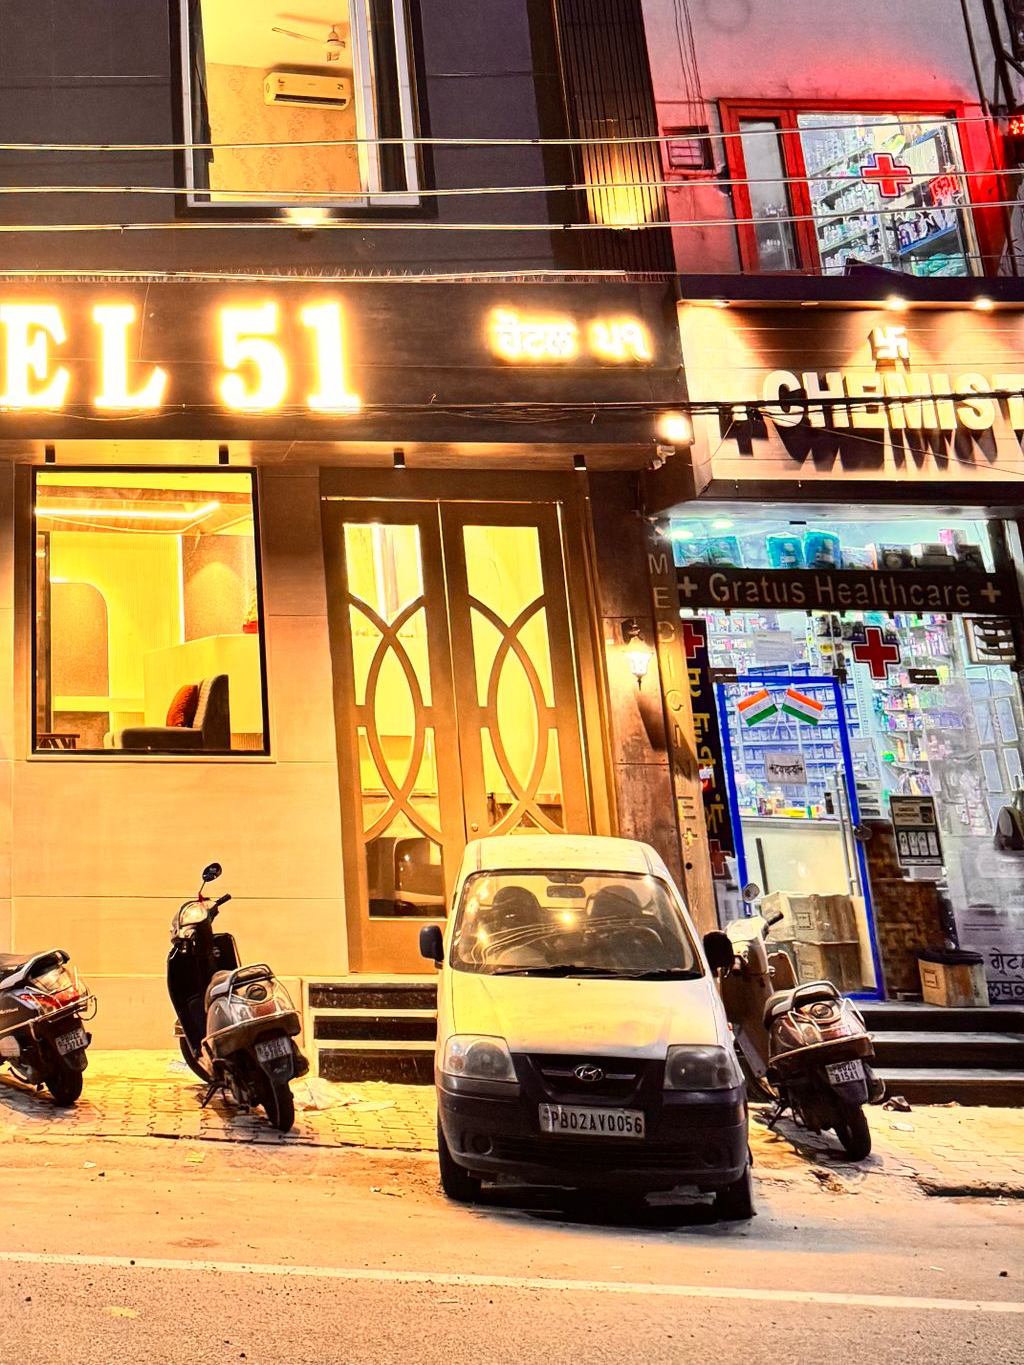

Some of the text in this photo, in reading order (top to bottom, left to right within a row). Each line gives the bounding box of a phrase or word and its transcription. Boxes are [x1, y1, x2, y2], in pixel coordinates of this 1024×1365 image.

[217, 300, 363, 413] 51
[708, 572, 972, 607] Gratus Healthcare
[551, 1111, 643, 1134] PB02AV0056
